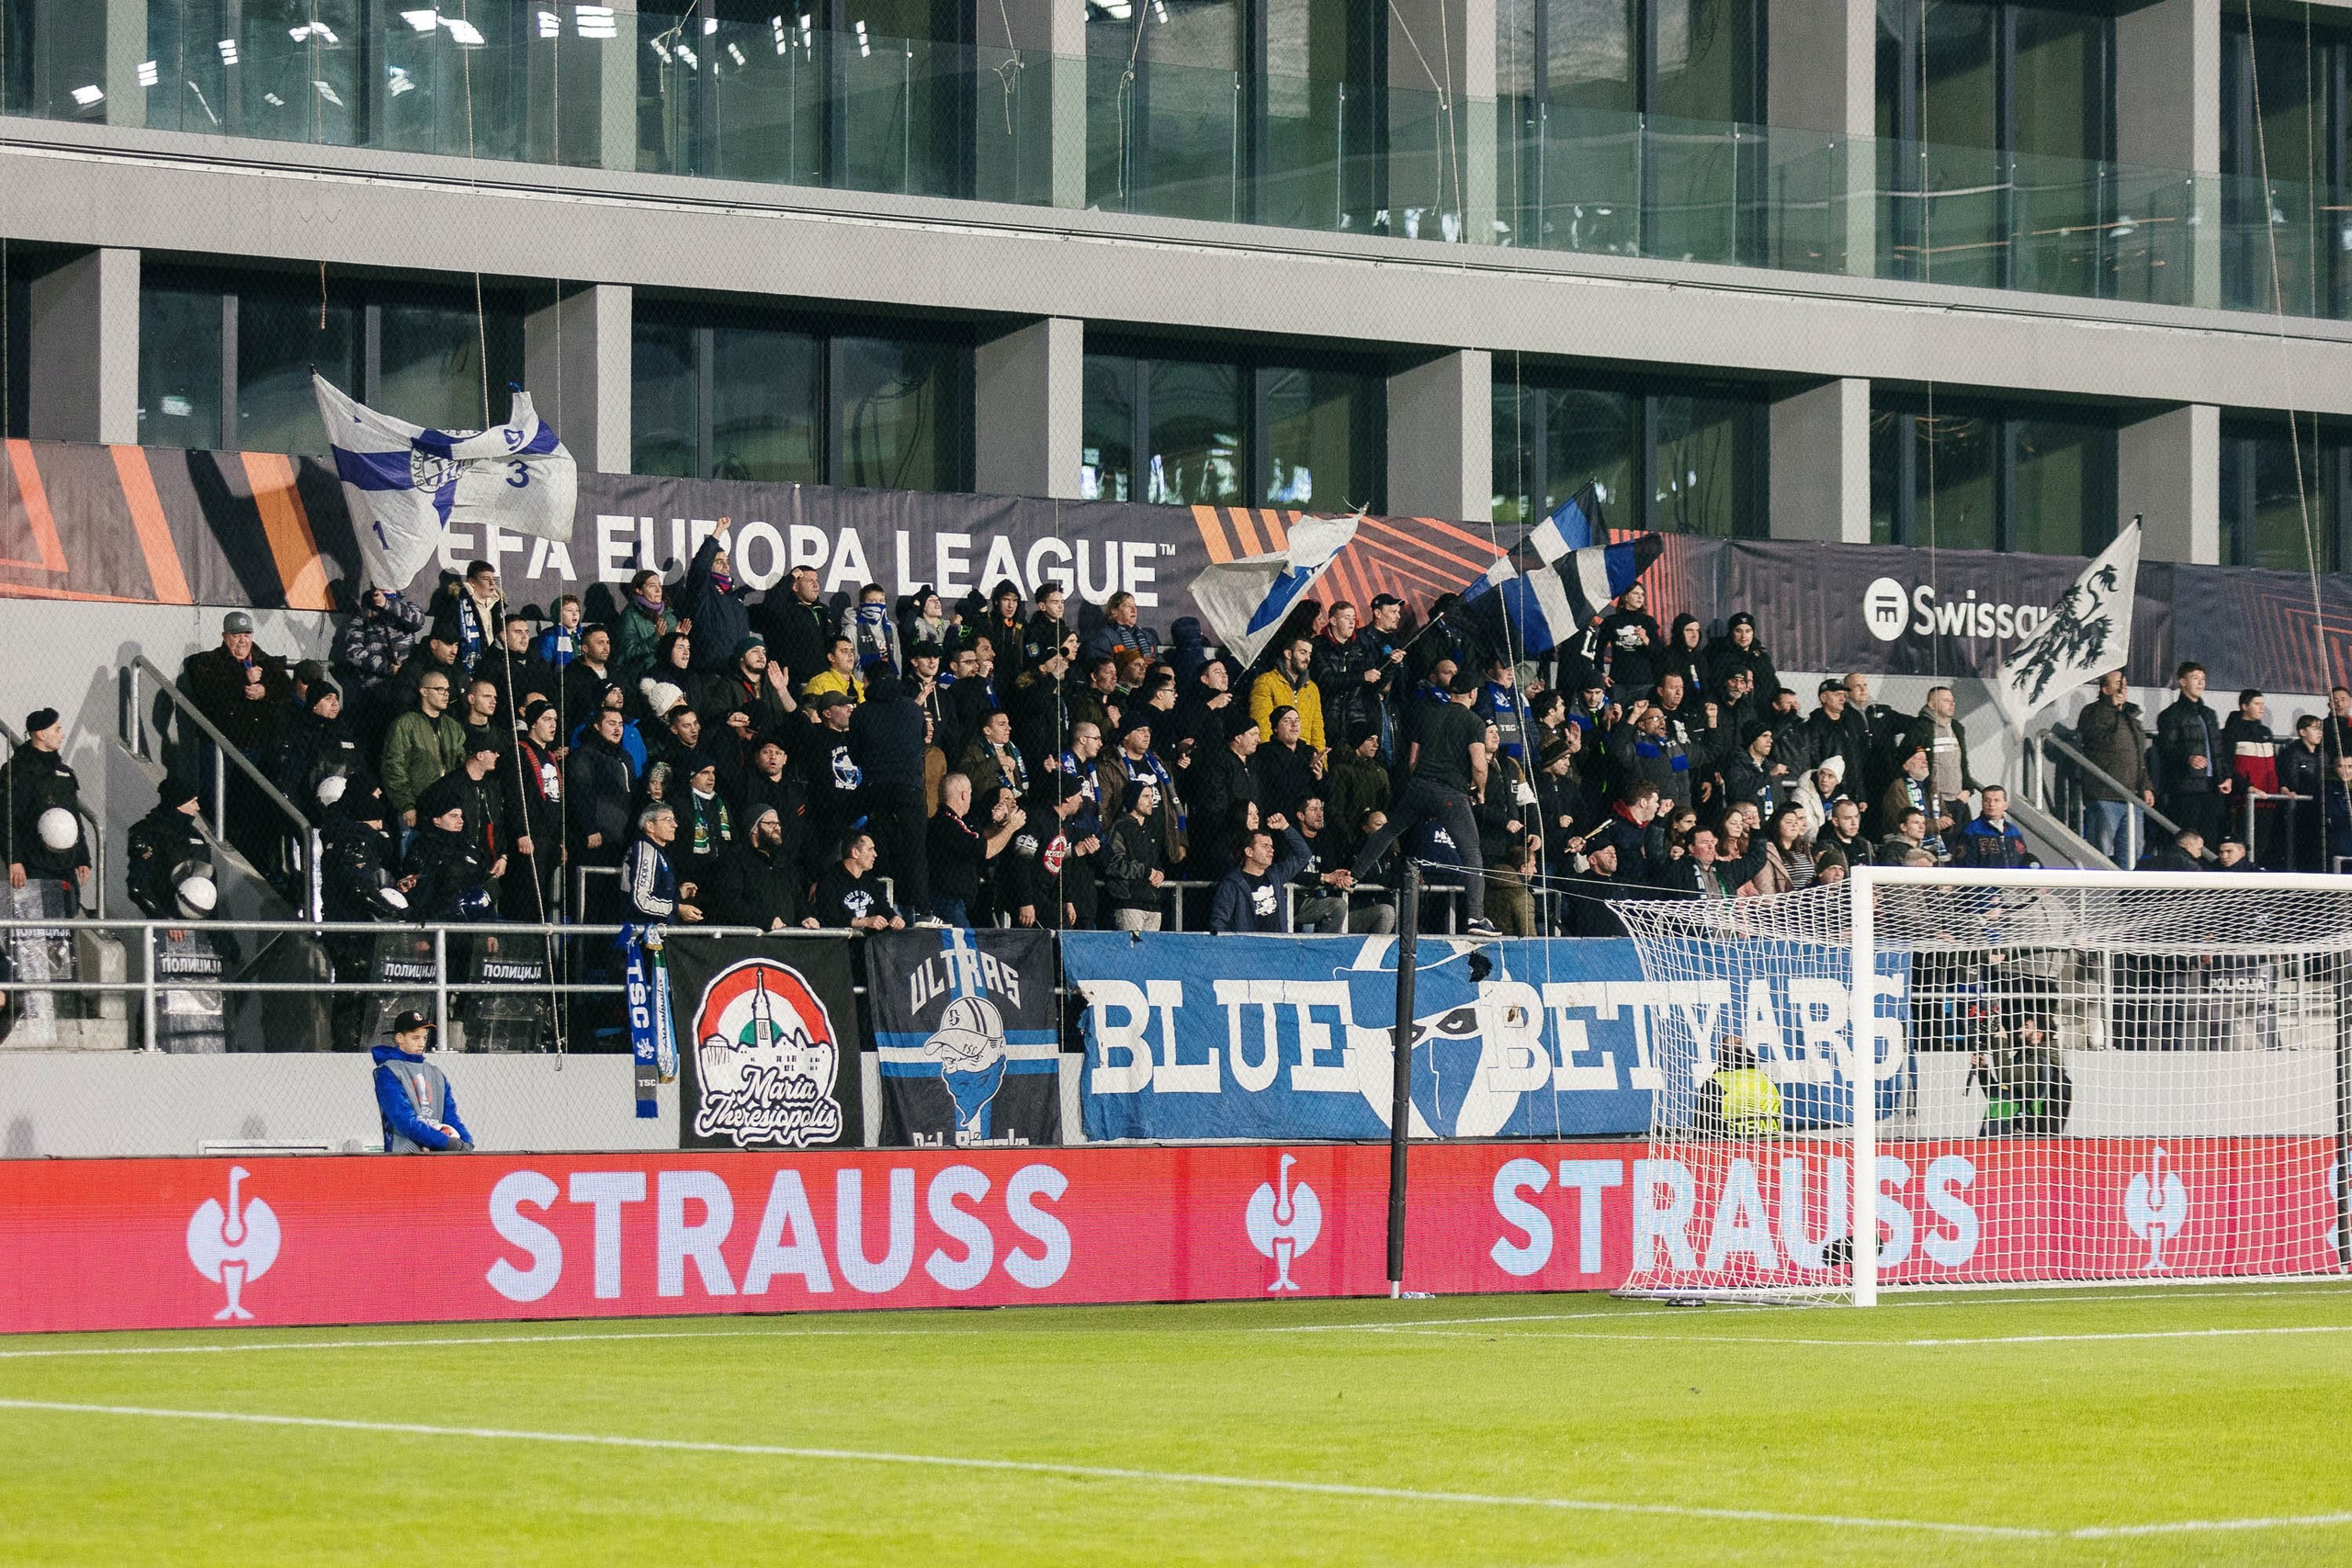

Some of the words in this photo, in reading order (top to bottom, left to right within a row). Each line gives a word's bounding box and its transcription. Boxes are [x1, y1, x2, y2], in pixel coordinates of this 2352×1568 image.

[505, 459, 530, 488] 3
[437, 520, 577, 581] EFA
[1912, 584, 2048, 640] Swissq
[162, 958, 222, 974] ПОЛИЦИЈА
[483, 964, 542, 981] ПОЛИЦИЈА
[628, 958, 650, 1029] TSC
[910, 948, 1021, 1016] ULTRAS
[1078, 979, 1360, 1094] BLUE
[1478, 974, 1905, 1092] BETYARS
[638, 1078, 657, 1088] TSC
[737, 1067, 817, 1108] Maria
[701, 1093, 838, 1138] Theresiopolis
[485, 1164, 1072, 1303] STRAUSS
[1489, 1154, 1979, 1276] STRAUSS
